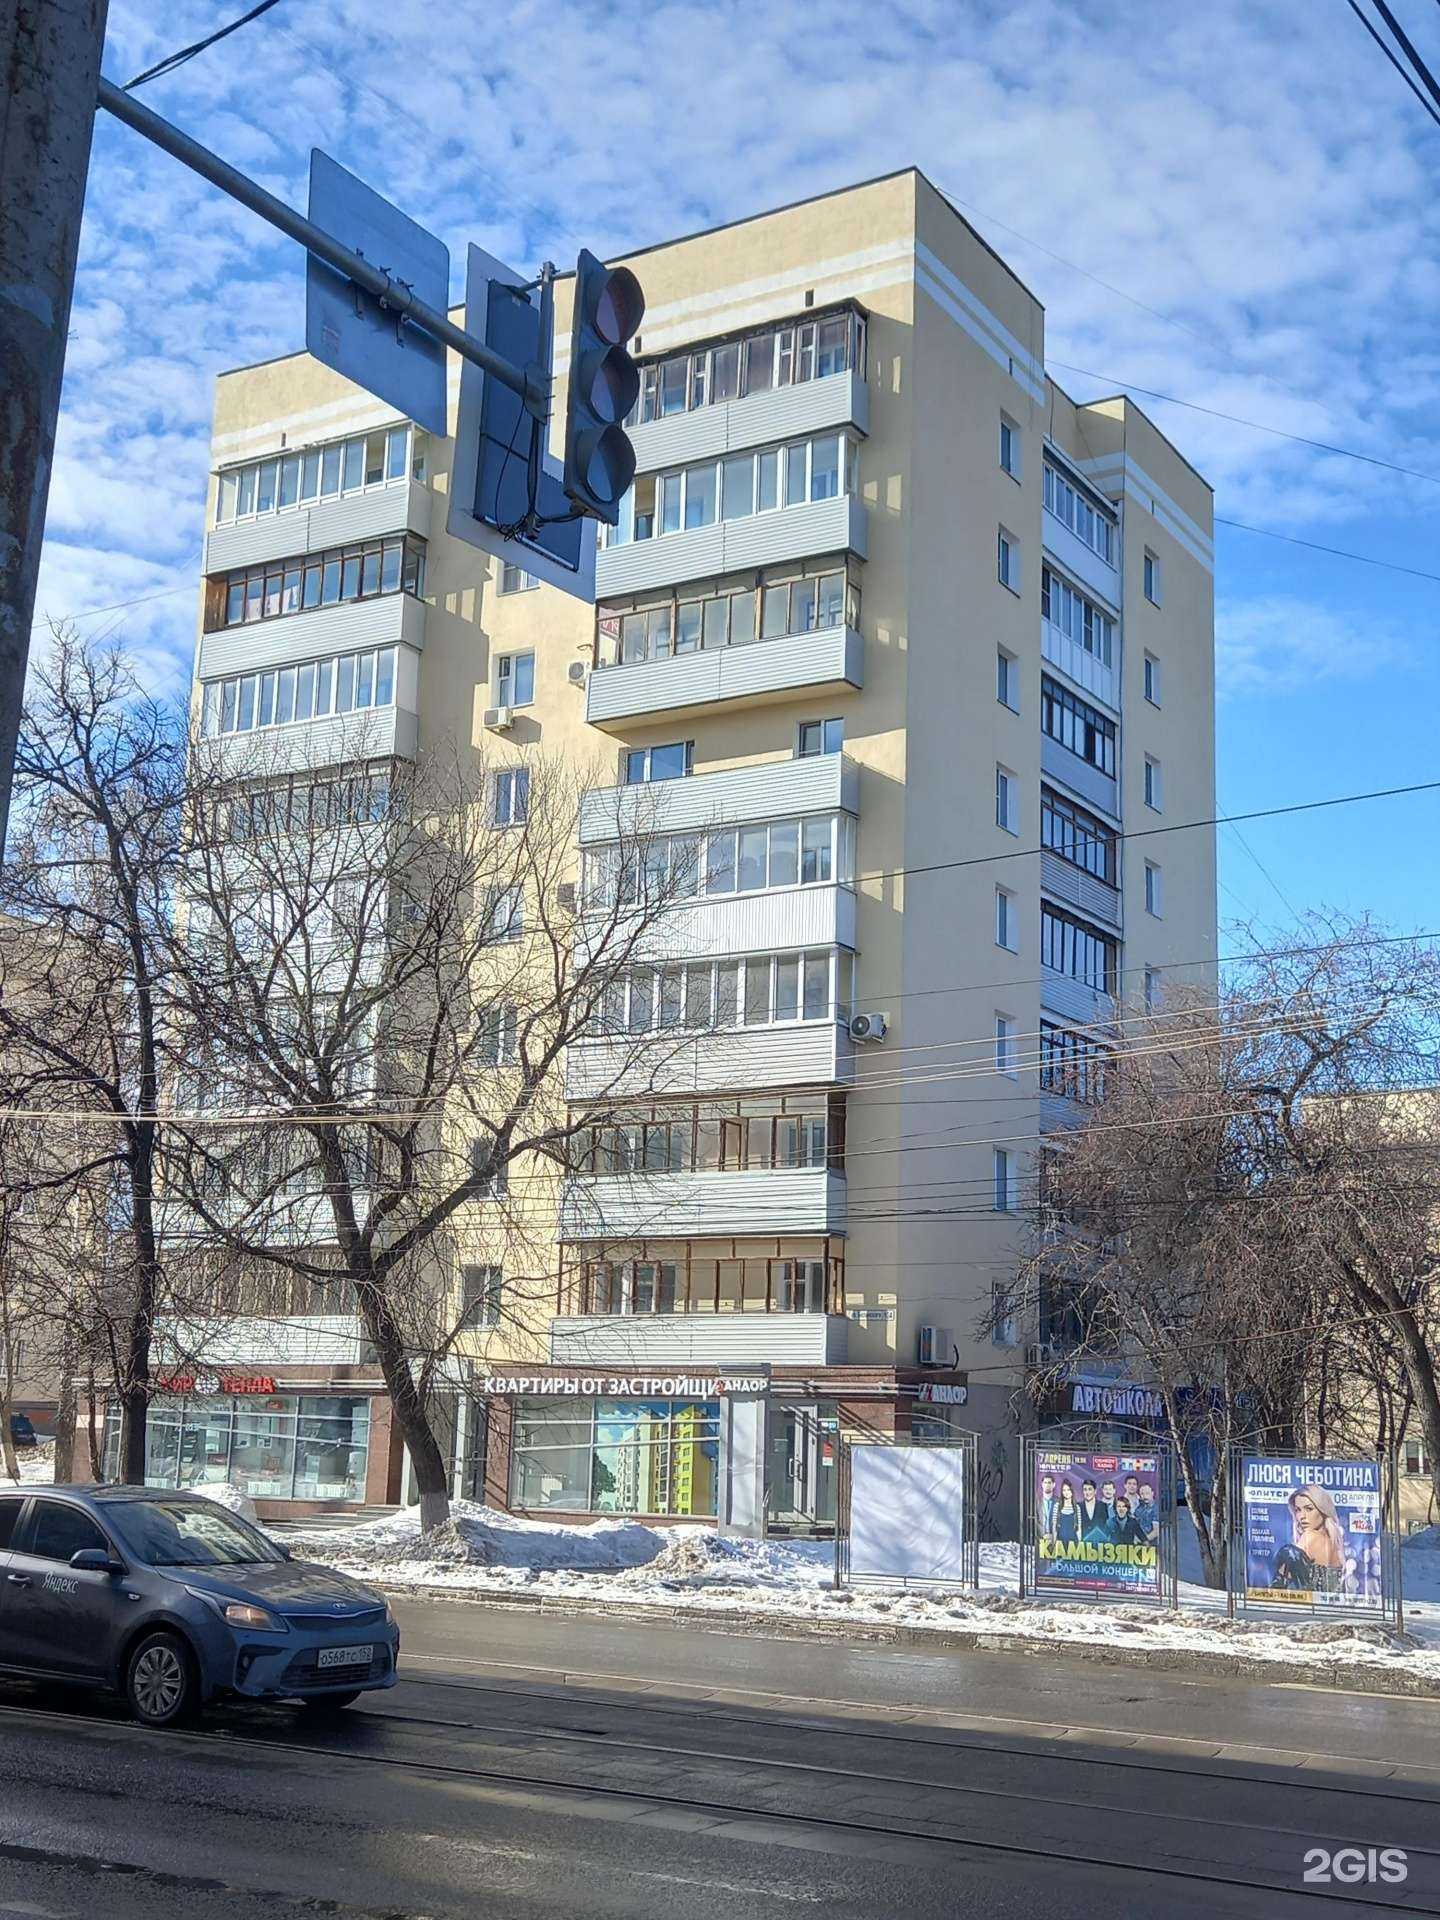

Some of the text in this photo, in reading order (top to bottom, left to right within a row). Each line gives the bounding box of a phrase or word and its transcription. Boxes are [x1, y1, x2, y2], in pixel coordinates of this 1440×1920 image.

[484, 1377, 579, 1394] КВАРТИРЫ
[581, 1378, 606, 1394] ОТ
[723, 1379, 767, 1392] АНДОР
[1072, 1385, 1164, 1418] АВТОШКОЛА
[1247, 1463, 1375, 1488] ЛЮСЯ ЧЕБОТИНА
[1334, 1493, 1348, 1504] 08
[1039, 1538, 1156, 1566] КАМЫЗЯКИ
[42, 1571, 79, 1594] Яндекс
